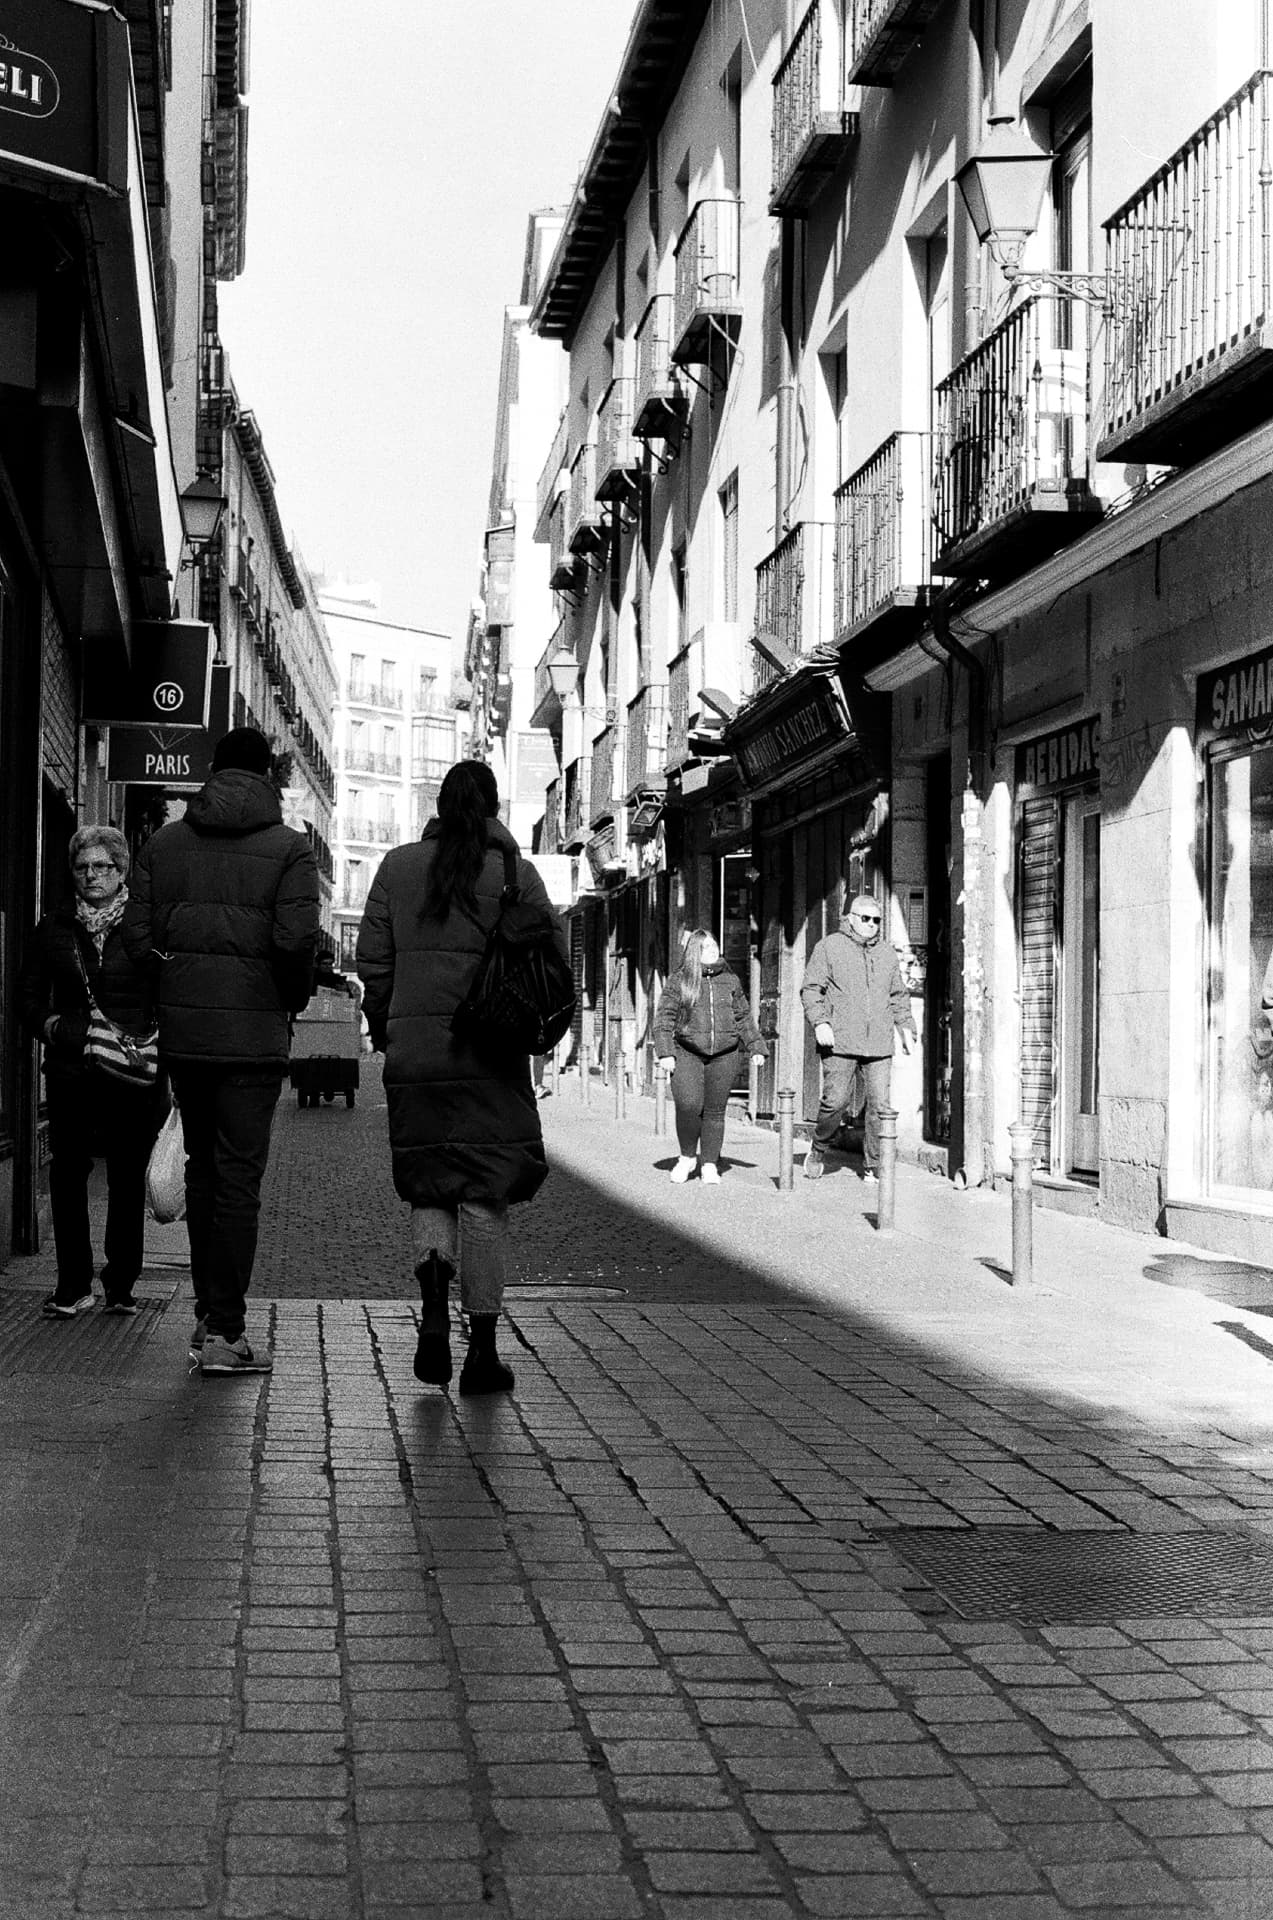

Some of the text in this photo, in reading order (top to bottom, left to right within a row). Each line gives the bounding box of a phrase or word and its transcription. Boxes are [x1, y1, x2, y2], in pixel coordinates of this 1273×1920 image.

[159, 688, 176, 705] 16
[145, 753, 190, 776] PARIS
[1025, 720, 1101, 787] BEBIDAS
